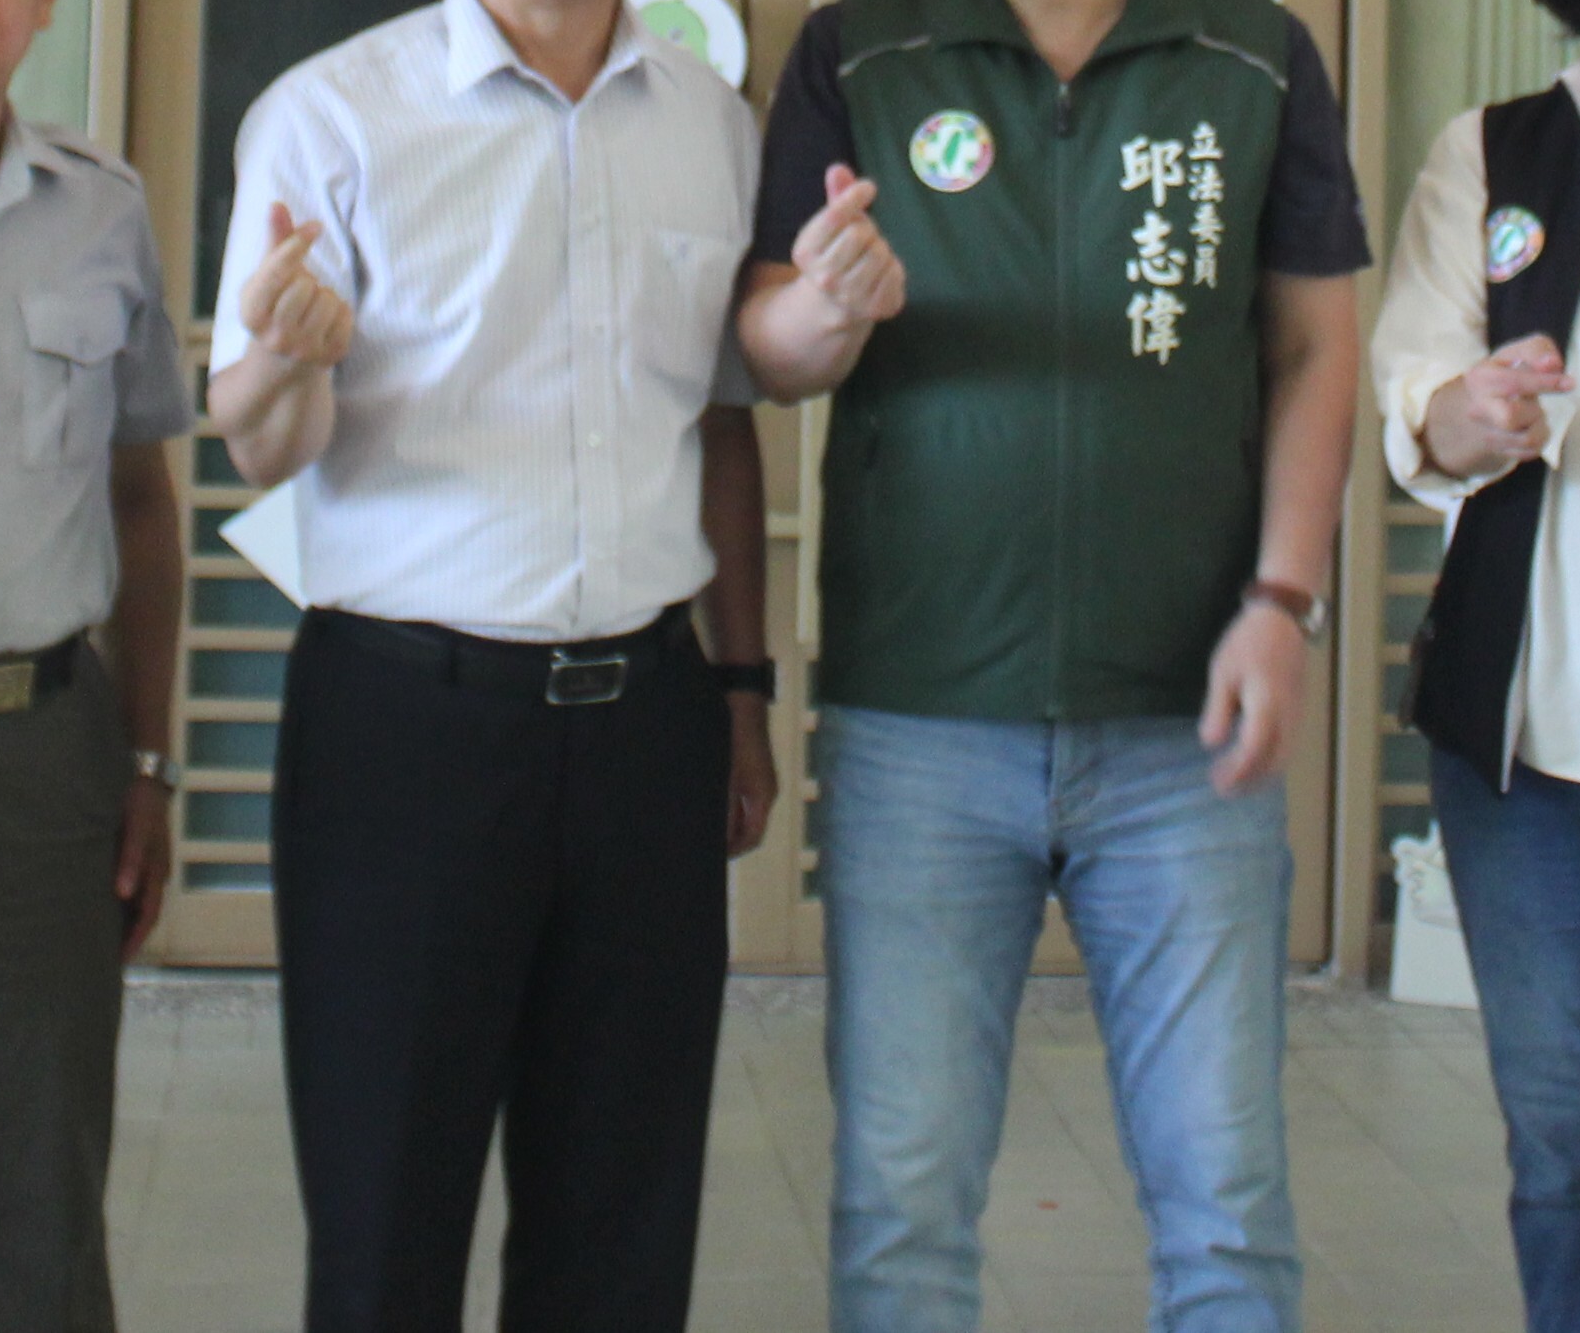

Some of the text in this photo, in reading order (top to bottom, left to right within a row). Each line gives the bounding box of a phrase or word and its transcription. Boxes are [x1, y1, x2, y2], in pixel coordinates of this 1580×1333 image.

[1120, 133, 1188, 366] 邱志偉
[1188, 120, 1224, 288] 立法委員
